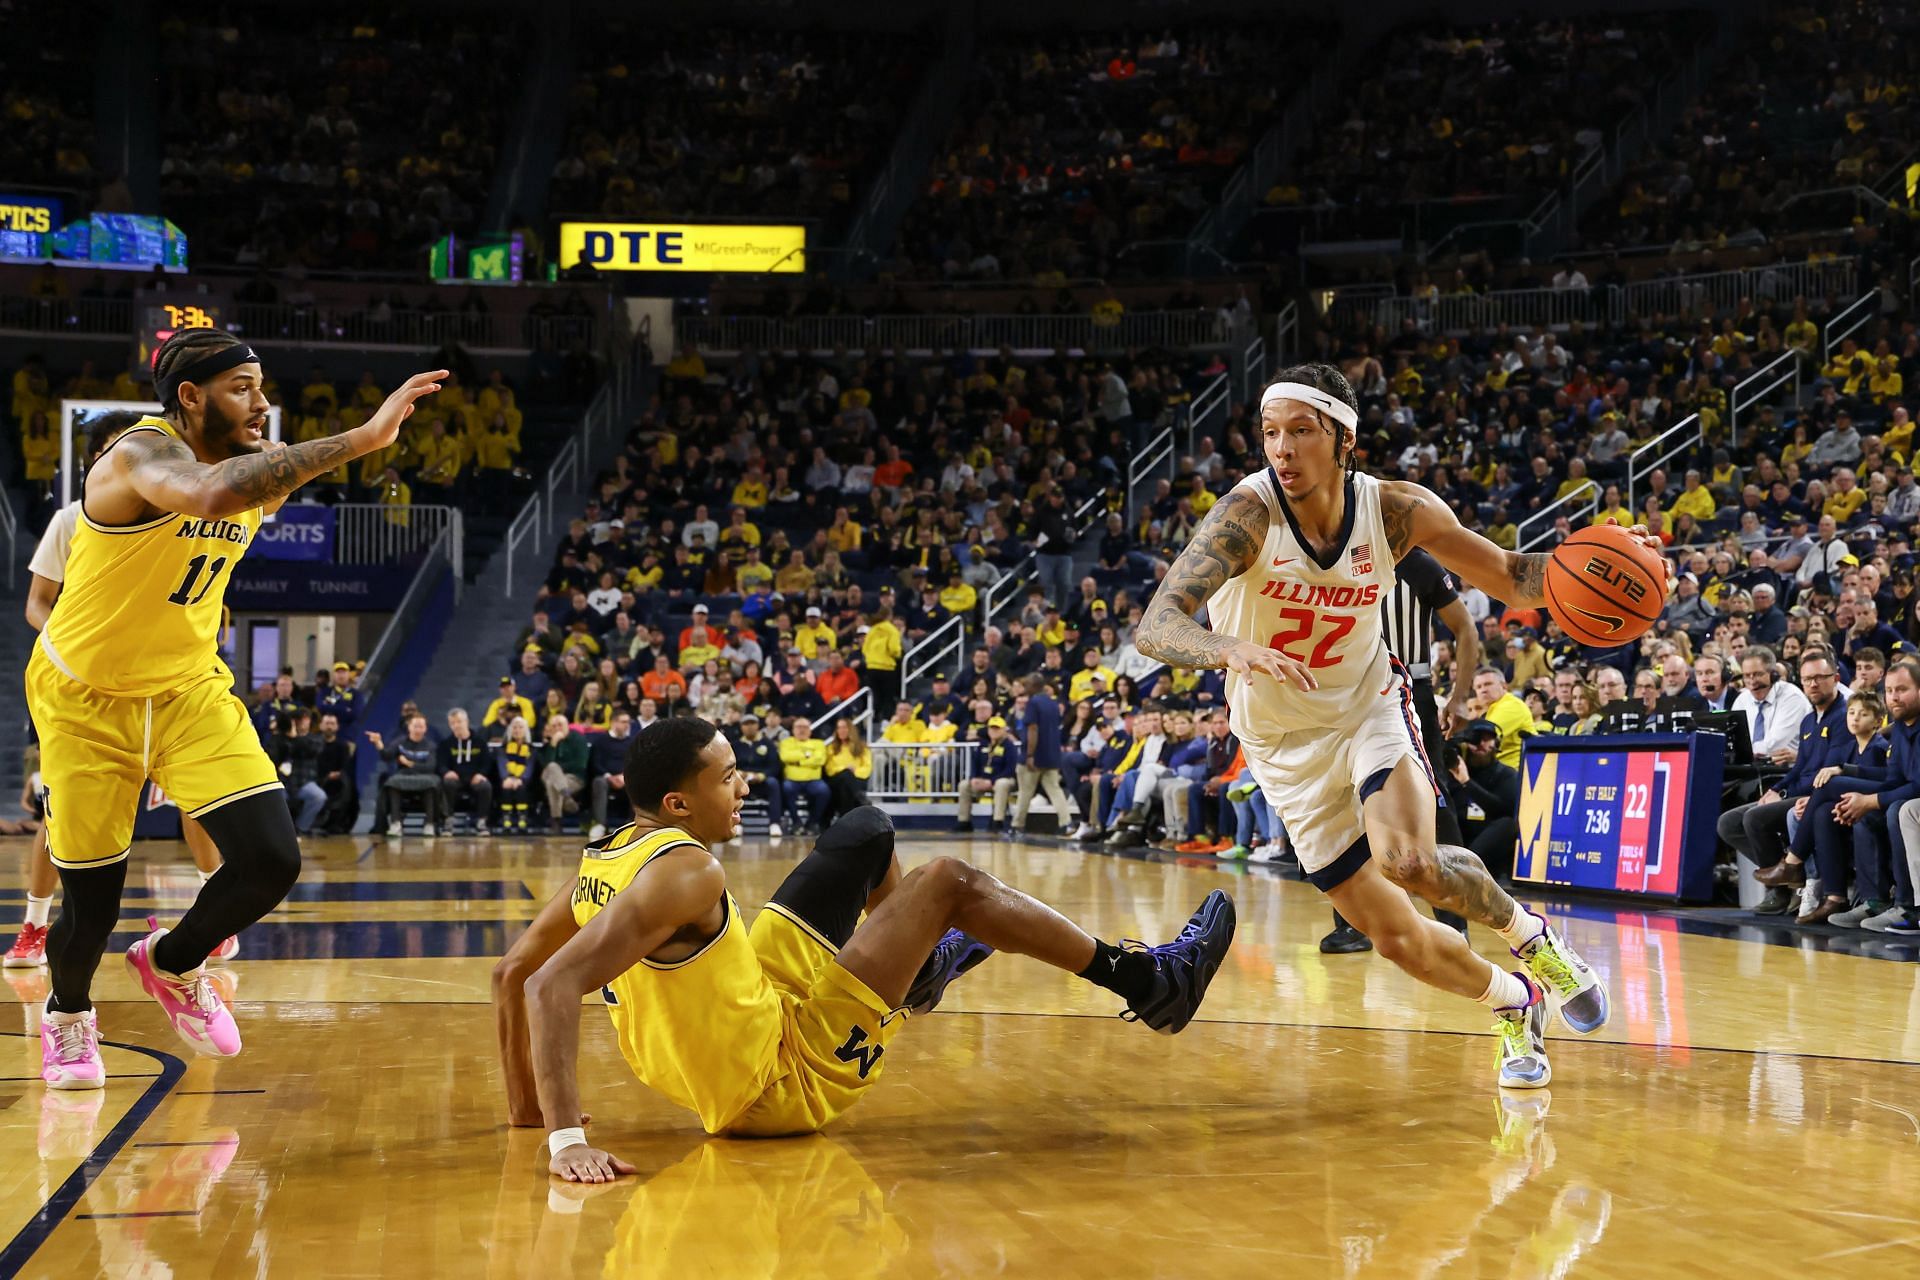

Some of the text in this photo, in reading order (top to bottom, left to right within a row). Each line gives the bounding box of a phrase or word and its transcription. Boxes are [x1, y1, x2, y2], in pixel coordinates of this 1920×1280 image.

[585, 231, 683, 264] DTE
[163, 305, 213, 329] 7:36
[168, 554, 227, 606] 11
[235, 580, 368, 593] FAMILY TUNNEL
[1584, 557, 1646, 604] ELITE
[1260, 581, 1379, 607] ILLINOIS
[1269, 608, 1356, 668] 22
[1557, 783, 1576, 815] 17
[1598, 786, 1617, 801] HALF
[1625, 784, 1648, 818] 22
[1585, 809, 1610, 834] 7:36
[1567, 841, 1573, 853] 2
[1620, 845, 1638, 858] FOULS
[1562, 855, 1568, 868] 4
[1634, 861, 1641, 873] 4
[834, 1025, 884, 1080] M
